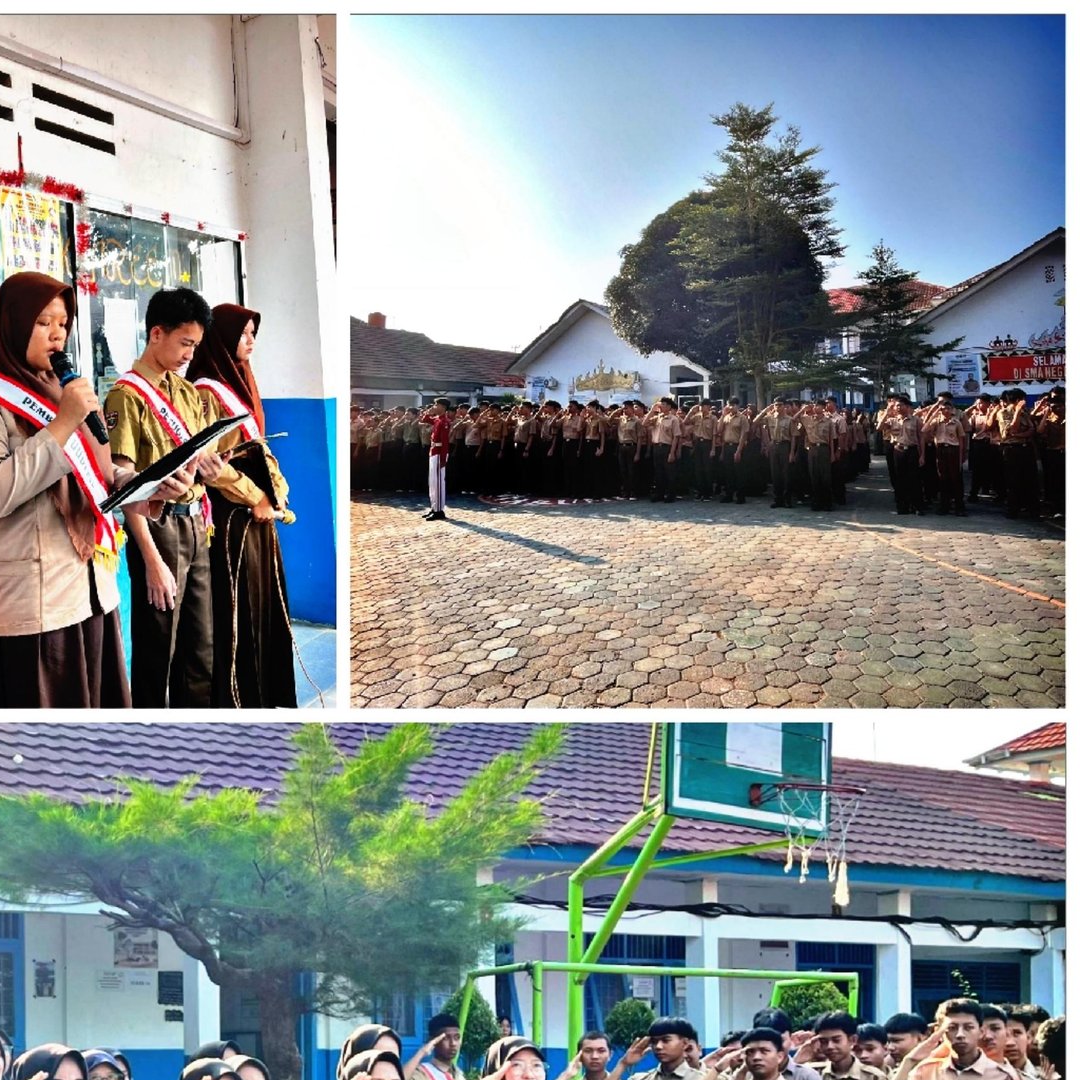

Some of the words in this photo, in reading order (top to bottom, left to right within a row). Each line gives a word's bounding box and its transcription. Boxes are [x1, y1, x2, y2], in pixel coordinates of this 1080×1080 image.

[1013, 367, 1022, 379] DI
[1024, 367, 1043, 379] SMA
[1044, 366, 1066, 378] NEG
